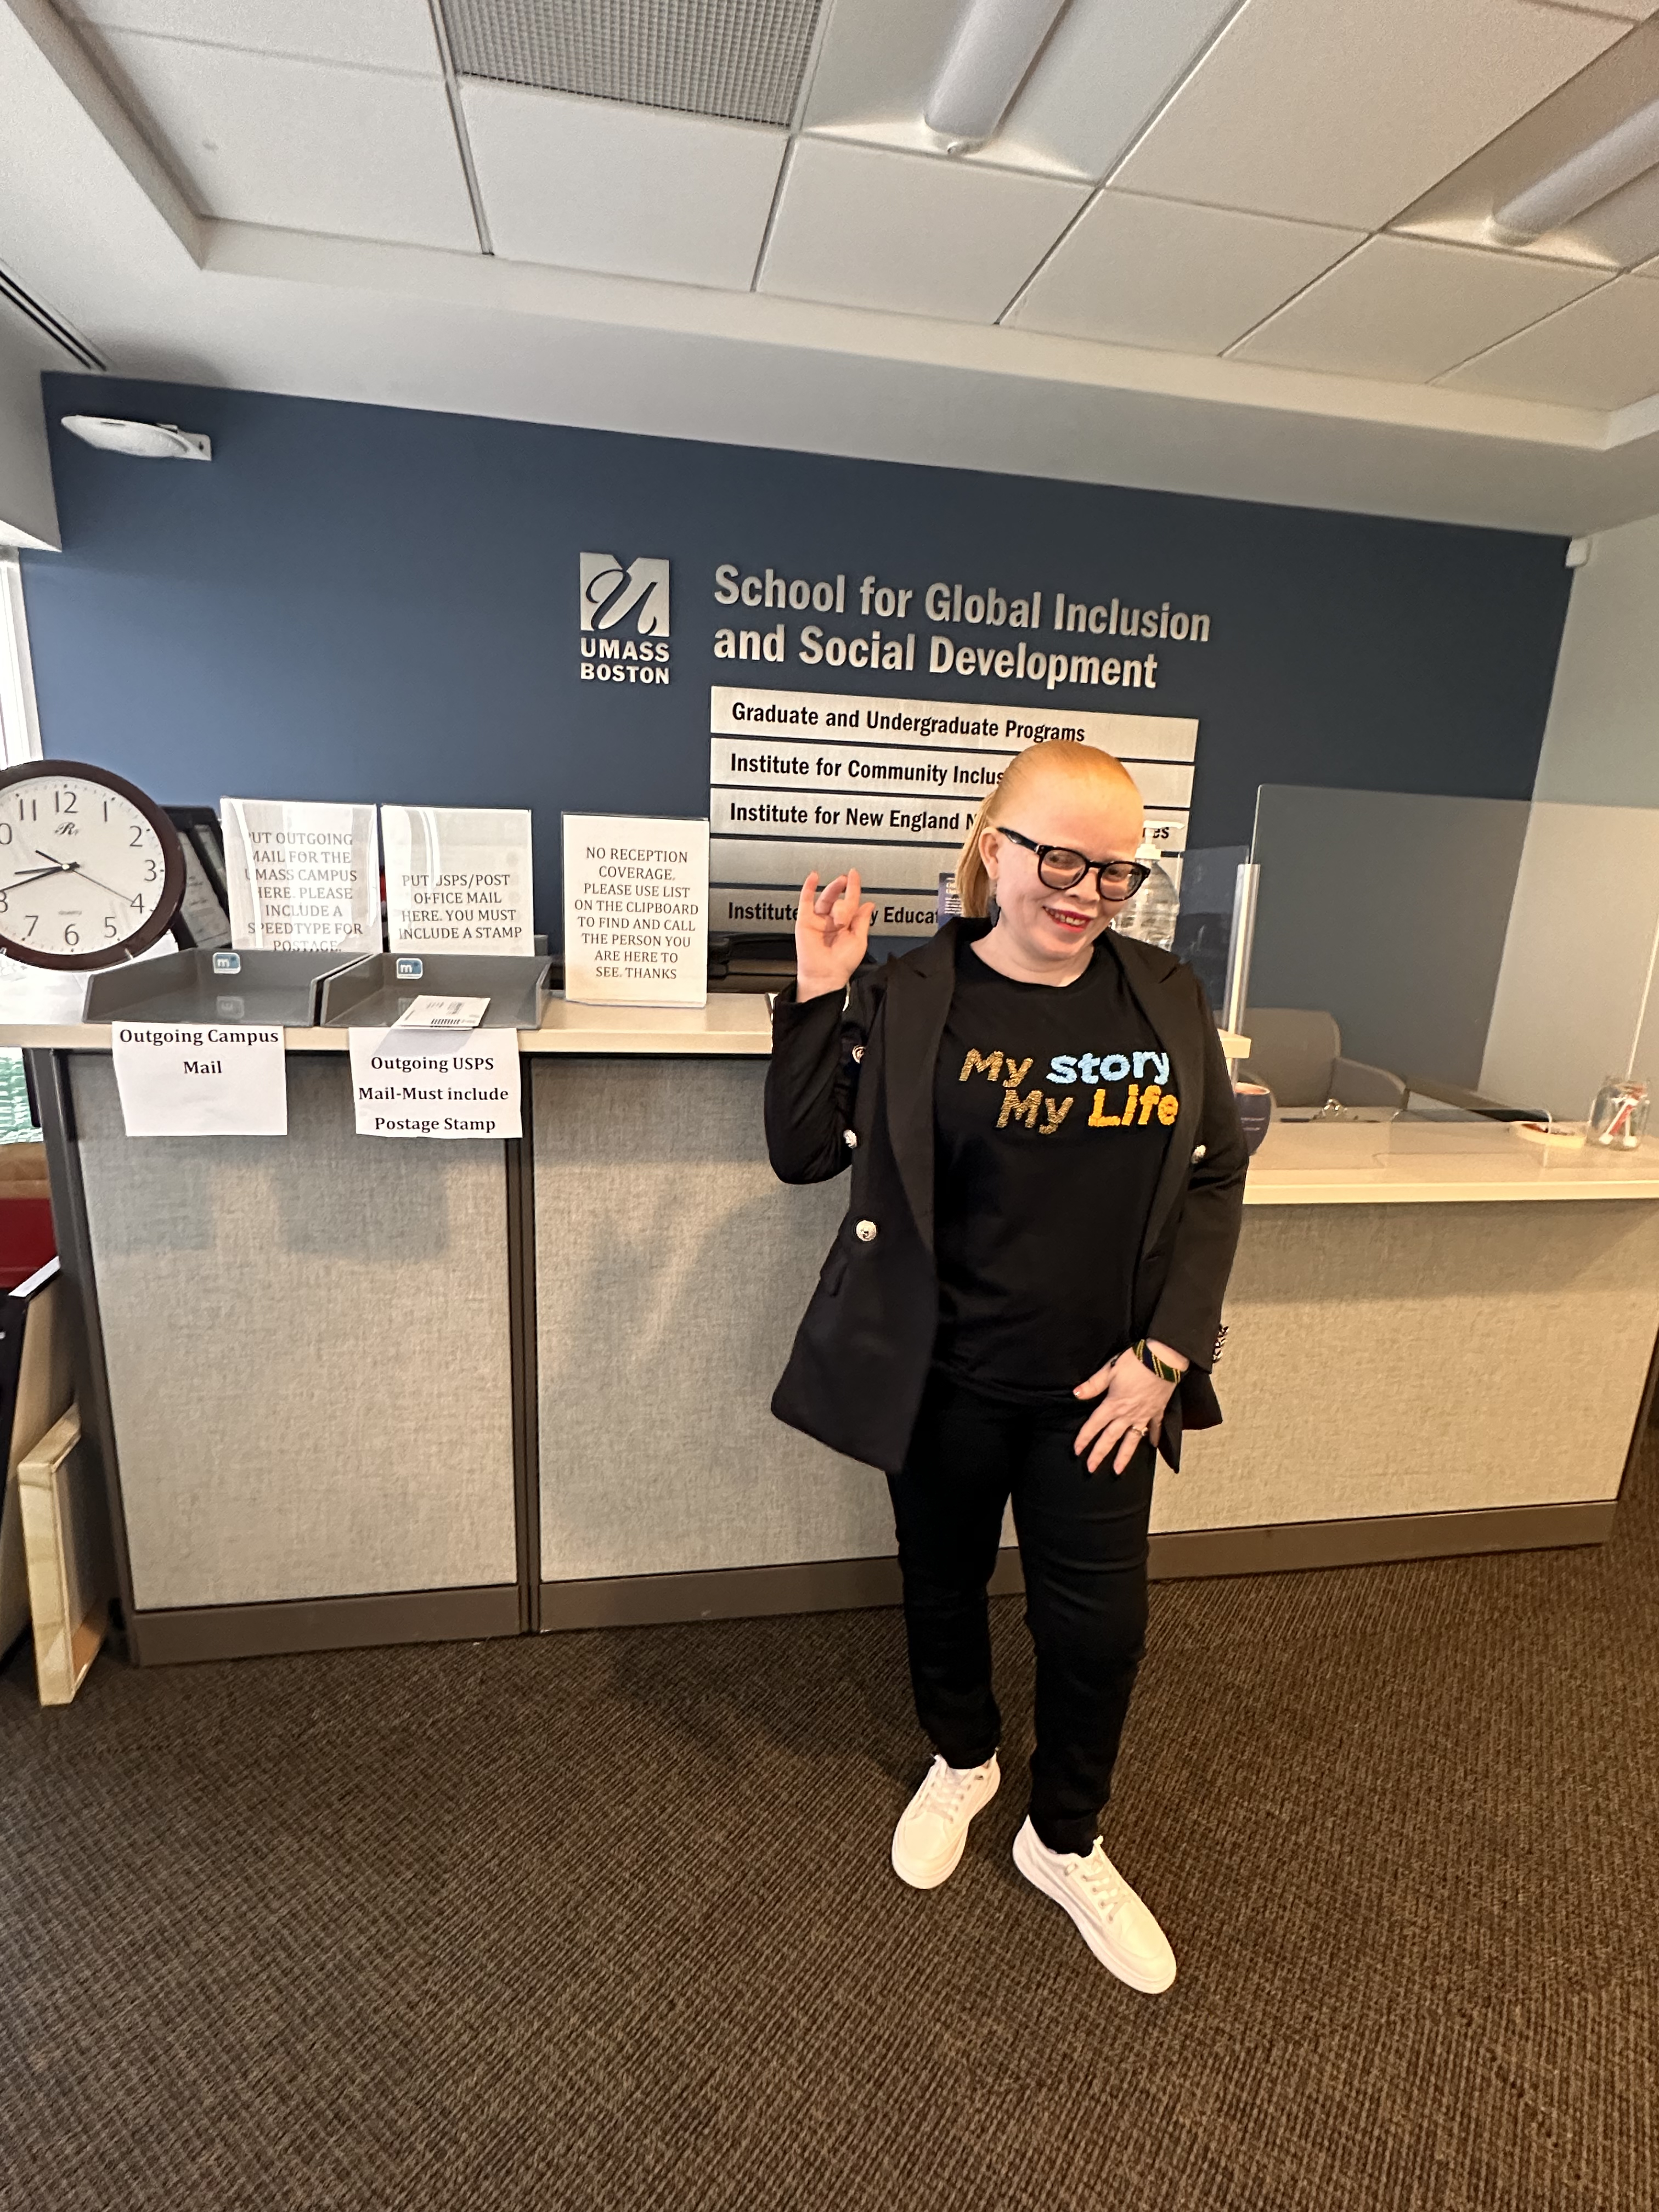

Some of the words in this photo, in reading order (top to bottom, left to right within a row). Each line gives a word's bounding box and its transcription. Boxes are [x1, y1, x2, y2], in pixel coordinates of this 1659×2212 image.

[714, 564, 845, 613] School
[860, 575, 912, 618] for
[925, 582, 1041, 629] Global
[1054, 592, 1211, 642] Inclusion
[580, 637, 670, 663] UMASS
[714, 624, 785, 662] and
[799, 625, 915, 670] Social
[929, 635, 1158, 690] Development
[580, 663, 670, 685] BOSTON
[732, 702, 819, 725] Graduate
[826, 710, 859, 728] and
[867, 710, 998, 737] Undergraduate
[1006, 720, 1085, 743] Programs
[731, 753, 809, 775] Institute
[816, 758, 842, 778] for
[848, 759, 947, 787] Community
[20, 799, 36, 821] 11
[55, 791, 78, 813] 12
[104, 800, 108, 822] 1
[730, 803, 808, 824] Institute
[815, 806, 840, 826] for
[845, 809, 883, 827] New
[890, 810, 960, 832] England
[129, 826, 143, 847] 2
[276, 832, 353, 845] OUTGOING
[289, 851, 318, 864] FOR
[321, 851, 352, 864] THE
[586, 847, 606, 859] NO
[610, 848, 688, 863] RECEPTION
[144, 860, 157, 882] 3
[298, 870, 358, 882] CAMPUS
[599, 866, 675, 881] COVERAGE.
[402, 874, 429, 887] PUT
[300, 887, 353, 900] PLEASE
[414, 892, 463, 904] OFFICE
[466, 891, 503, 904] MAIL
[584, 883, 631, 896] PLEASE
[636, 885, 659, 896] USE
[663, 886, 690, 898] LIST
[130, 893, 144, 913] 4
[266, 905, 329, 917] INCLUDE
[333, 906, 343, 917] A
[575, 900, 592, 911] ON
[596, 900, 623, 912] THE
[627, 901, 699, 915] CLIPBOARD
[402, 910, 443, 922] HERE.
[445, 910, 473, 921] YOU
[478, 910, 517, 921] MUST
[577, 916, 595, 928] TO
[599, 917, 629, 929] FIND
[633, 918, 661, 930] AND
[664, 919, 696, 932] CALL
[25, 915, 38, 937] 7
[104, 916, 117, 938] 5
[335, 923, 363, 935] FOR
[399, 927, 459, 940] INCLUDE
[462, 927, 472, 939] A
[476, 927, 522, 938] STAMP
[65, 923, 79, 946] 6
[582, 933, 608, 945] THE
[612, 934, 662, 947] PERSON
[665, 936, 691, 947] YOU
[595, 950, 620, 961] ARE
[624, 951, 658, 963] HERE
[661, 952, 678, 963] TO
[596, 967, 622, 978] SEE.
[625, 967, 678, 979] THANKS
[120, 1029, 202, 1047] Outgoing
[208, 1029, 279, 1046] Campus
[183, 1060, 222, 1074] Mail
[371, 1057, 448, 1073] Outgoing
[453, 1057, 494, 1070] USPS
[958, 1048, 1034, 1087] My
[1046, 1051, 1170, 1085] story
[359, 1087, 443, 1100] Mail-Must
[448, 1088, 509, 1100] include
[995, 1089, 1074, 1135] My
[1088, 1084, 1178, 1127] Life
[375, 1118, 439, 1133] Postage
[444, 1118, 496, 1133] Stamp
